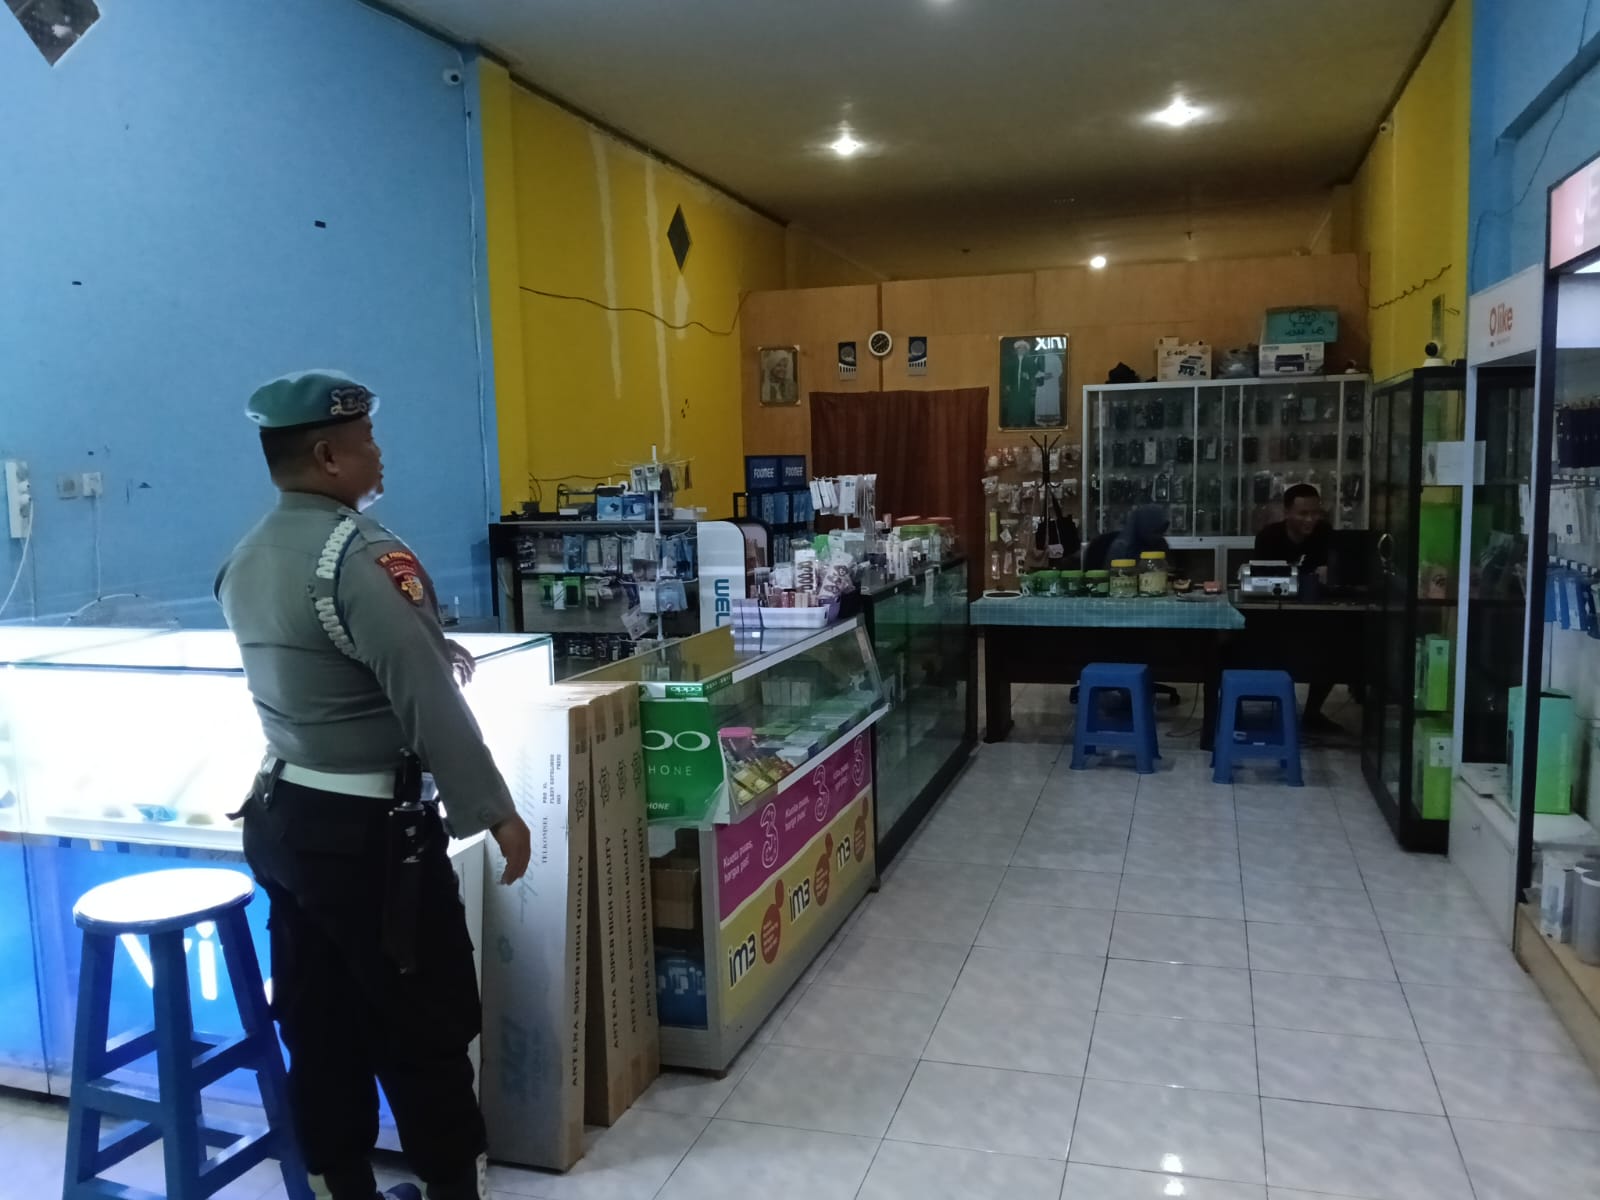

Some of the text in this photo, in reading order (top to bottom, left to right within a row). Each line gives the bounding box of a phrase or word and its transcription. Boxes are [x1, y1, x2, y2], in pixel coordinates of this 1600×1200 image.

[575, 855, 584, 919] QUALITY
[605, 836, 614, 897] QUALITY
[574, 924, 582, 962] HIGH
[729, 934, 756, 987] im3
[573, 966, 581, 1015] SUPER
